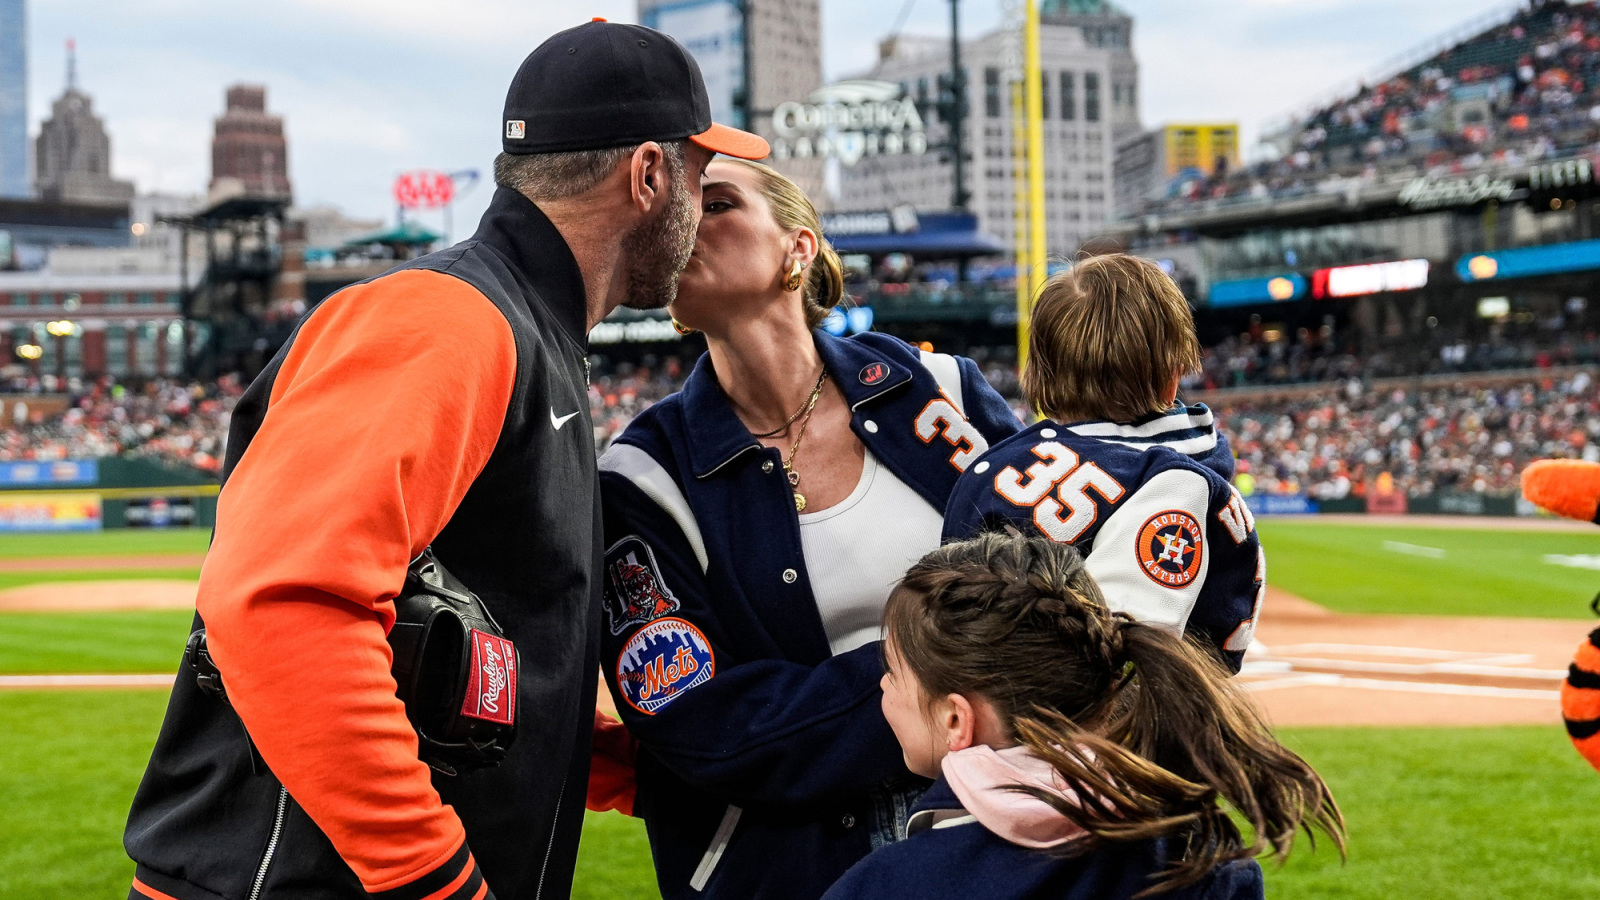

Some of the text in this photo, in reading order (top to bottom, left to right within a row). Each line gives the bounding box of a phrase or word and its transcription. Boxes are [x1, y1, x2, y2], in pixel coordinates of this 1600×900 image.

[994, 440, 1126, 544] 35
[1151, 513, 1202, 543] HOUSTON
[1158, 533, 1189, 565] H
[1144, 559, 1190, 583] ASTROS
[481, 640, 502, 713] Rawlings
[640, 646, 698, 700] Mets
